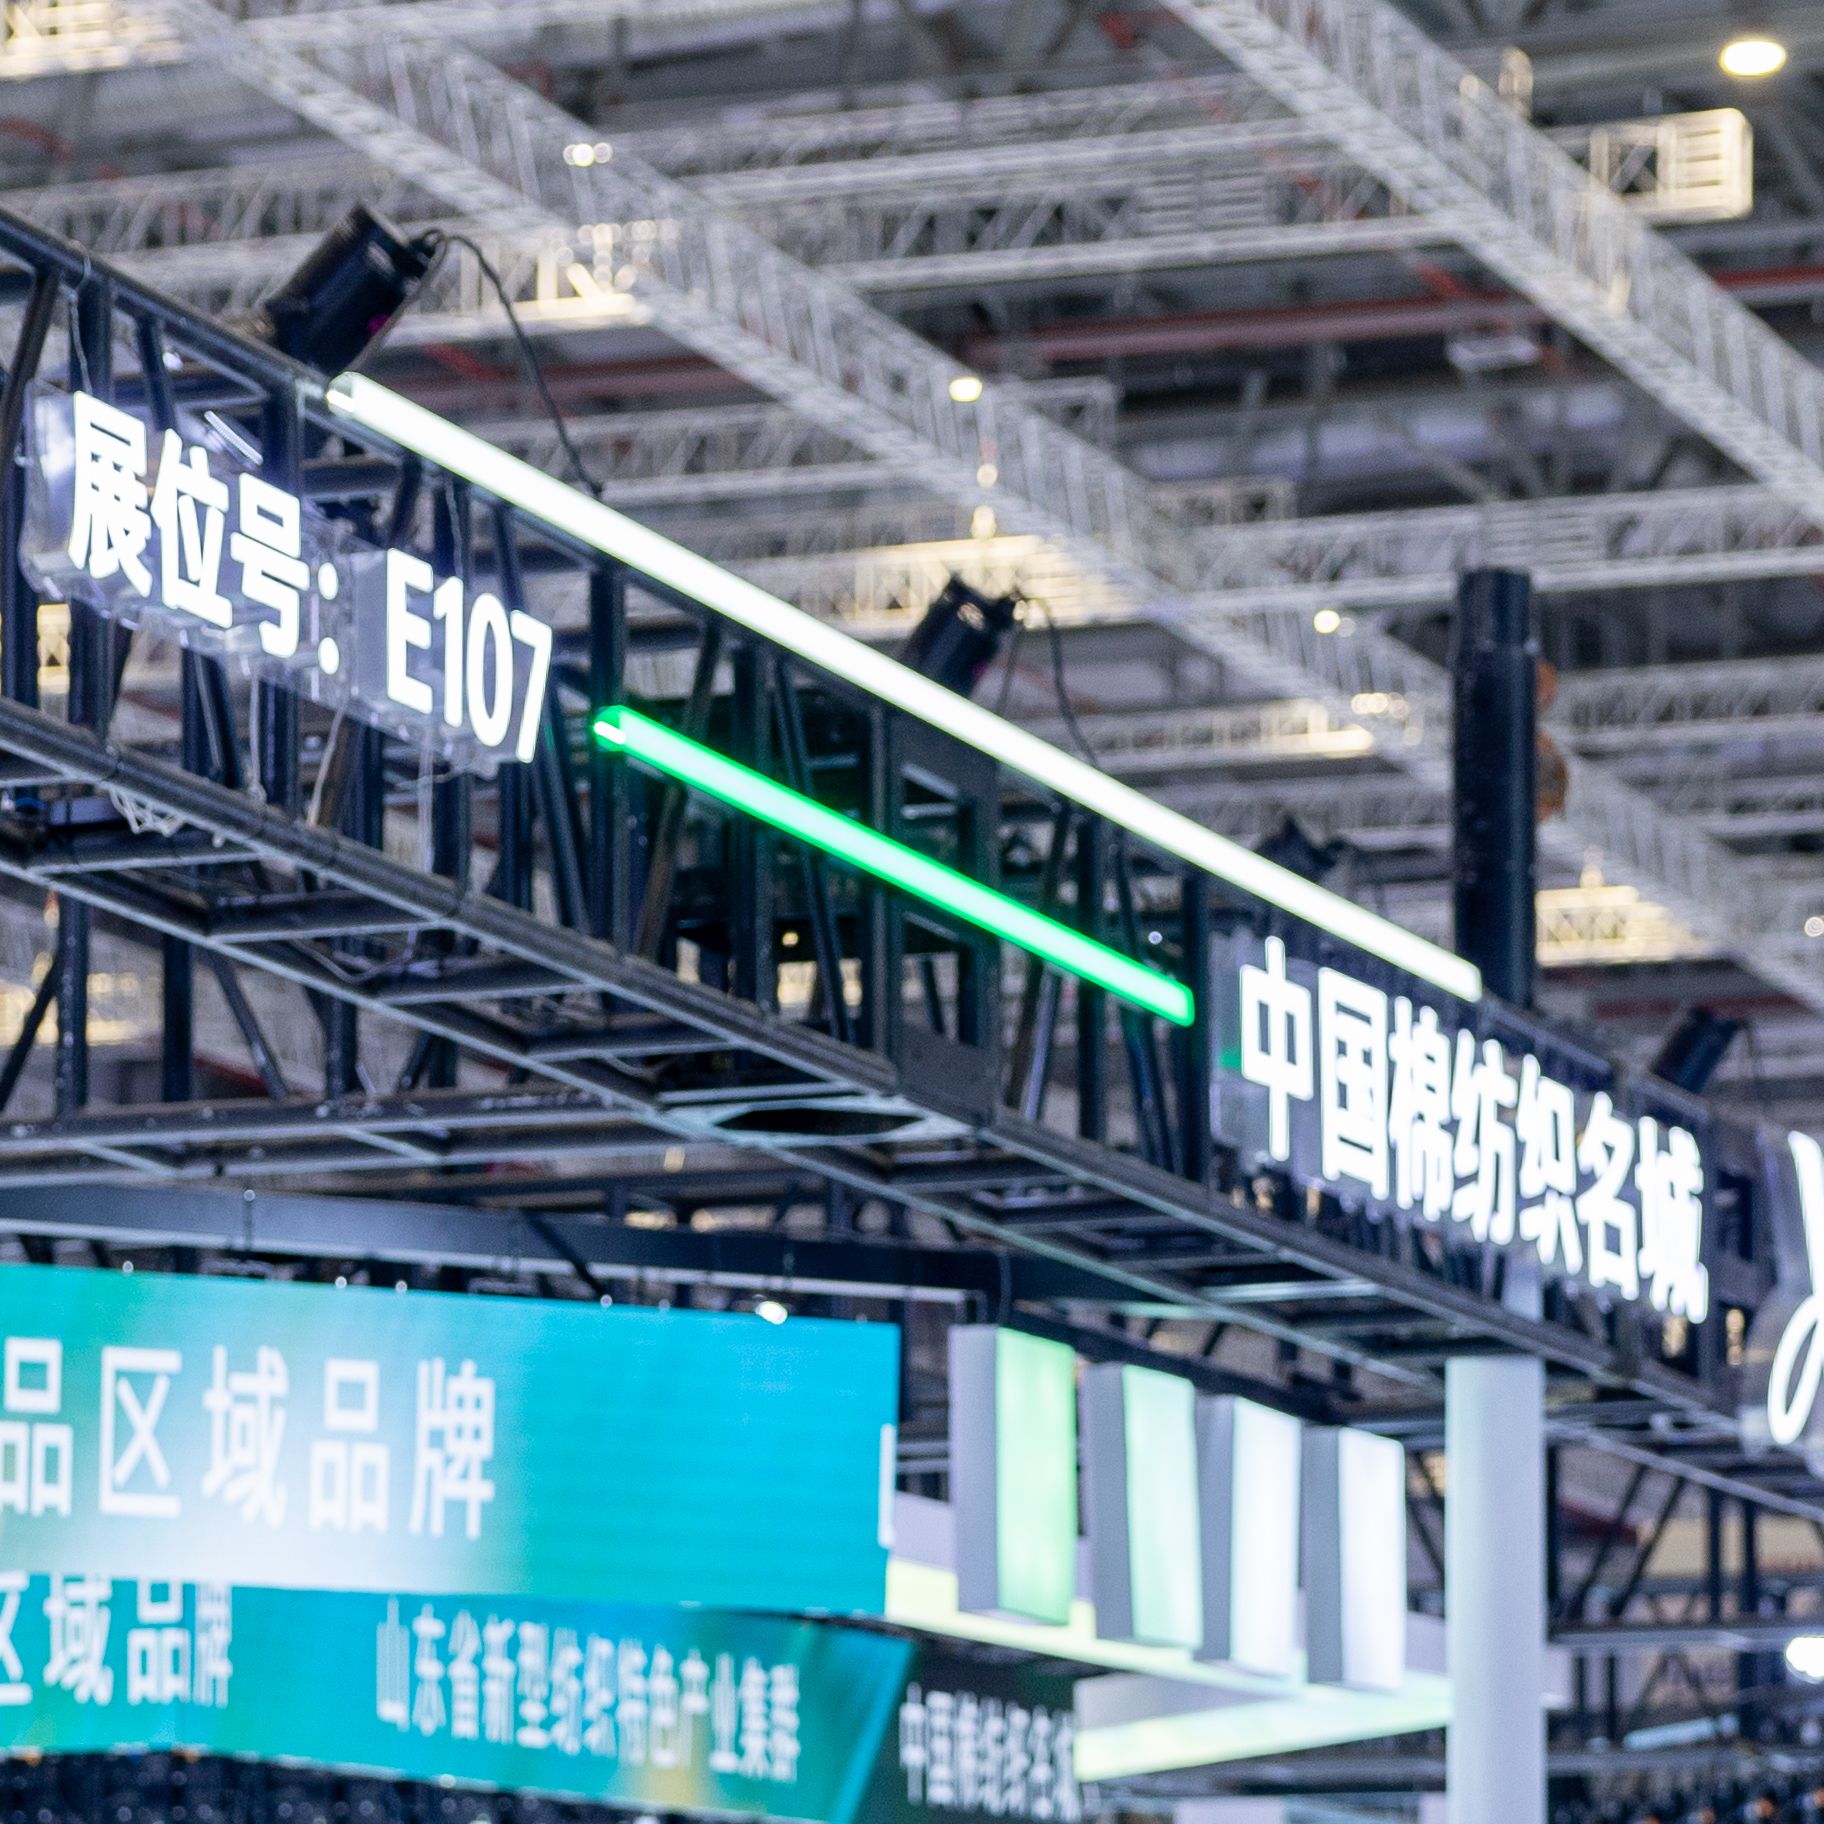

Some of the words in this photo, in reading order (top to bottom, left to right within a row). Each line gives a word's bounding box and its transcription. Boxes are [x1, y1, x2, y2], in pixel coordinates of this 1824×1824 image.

[1239, 936, 1709, 1324] 中国棉纺织名城
